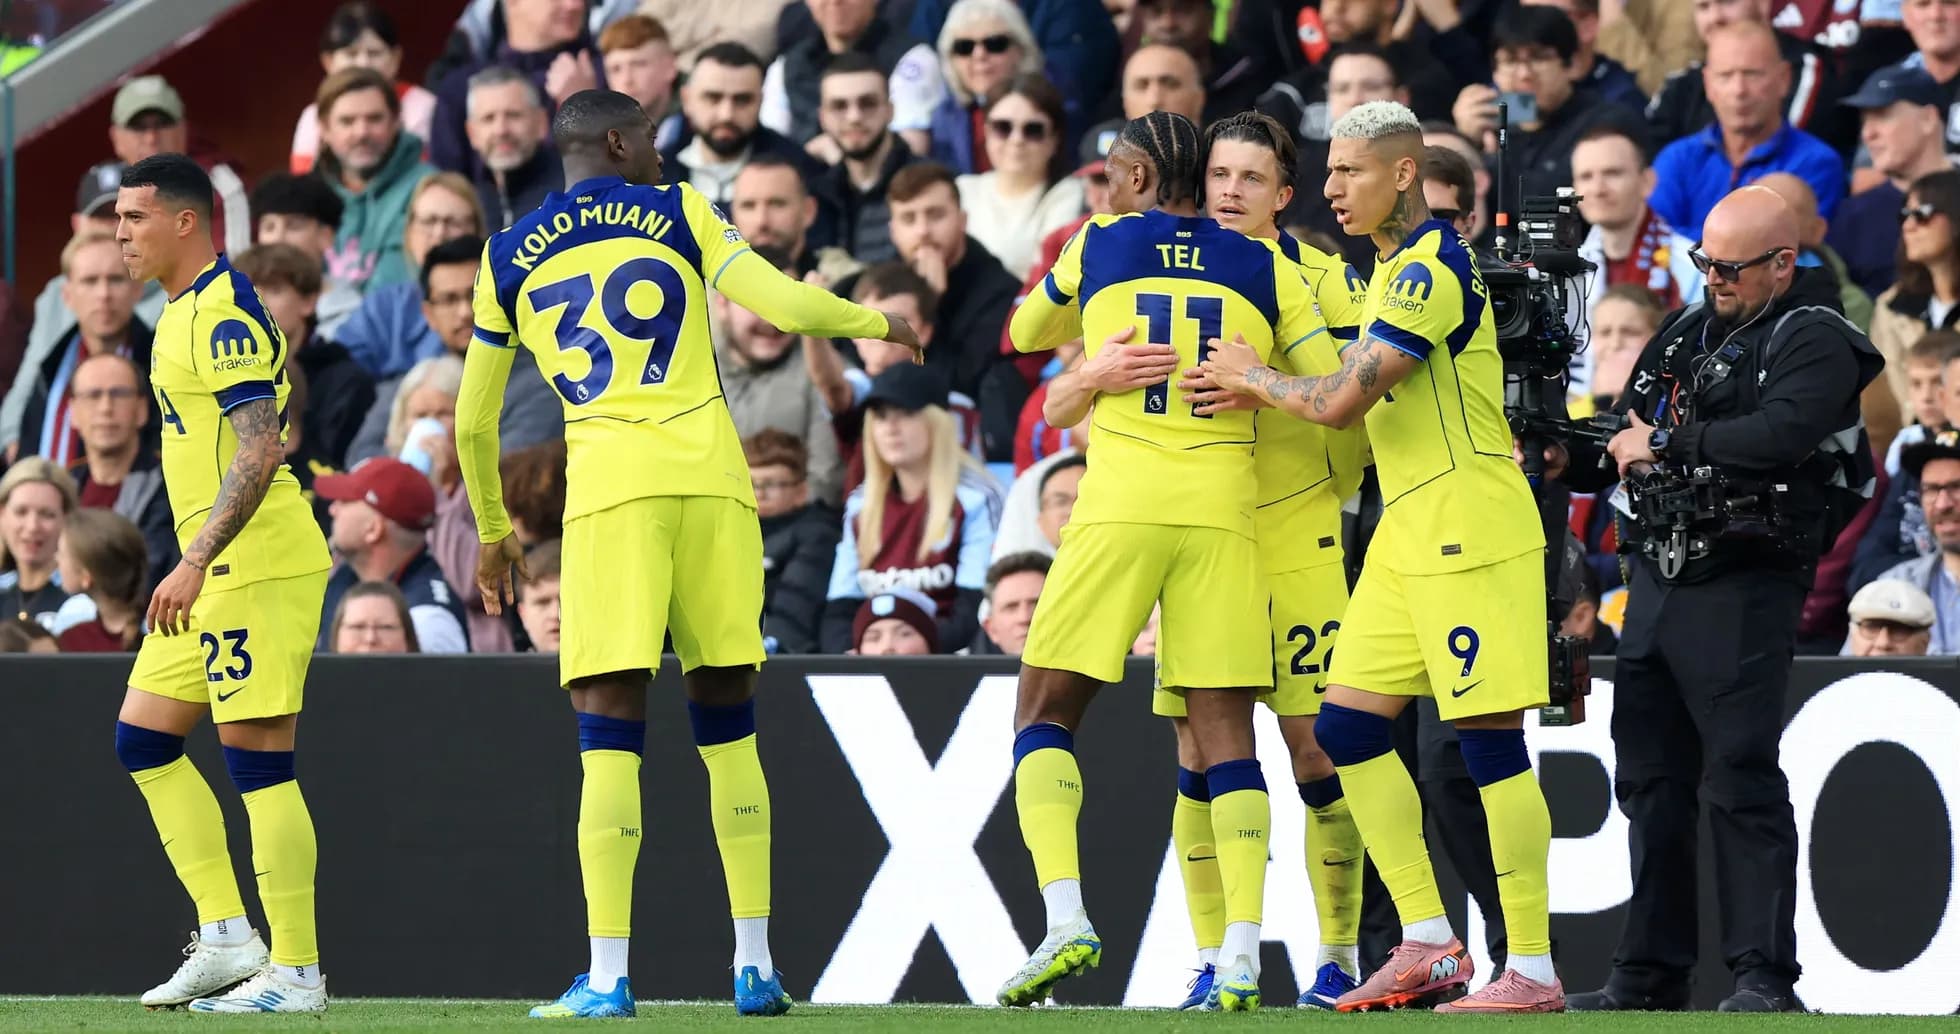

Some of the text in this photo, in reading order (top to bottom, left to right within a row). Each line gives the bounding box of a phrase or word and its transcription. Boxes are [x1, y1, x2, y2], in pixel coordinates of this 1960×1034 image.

[512, 202, 673, 271] KOLO MUANI
[1155, 244, 1205, 271] TEL
[527, 256, 687, 406] 39
[212, 357, 262, 373] kraken
[1135, 293, 1224, 419] 11
[199, 628, 253, 682] 23
[1447, 625, 1480, 677] 9
[1056, 779, 1080, 793] THFC
[733, 805, 760, 816] THFC
[619, 827, 640, 838] THFC
[1237, 829, 1262, 839] THFC
